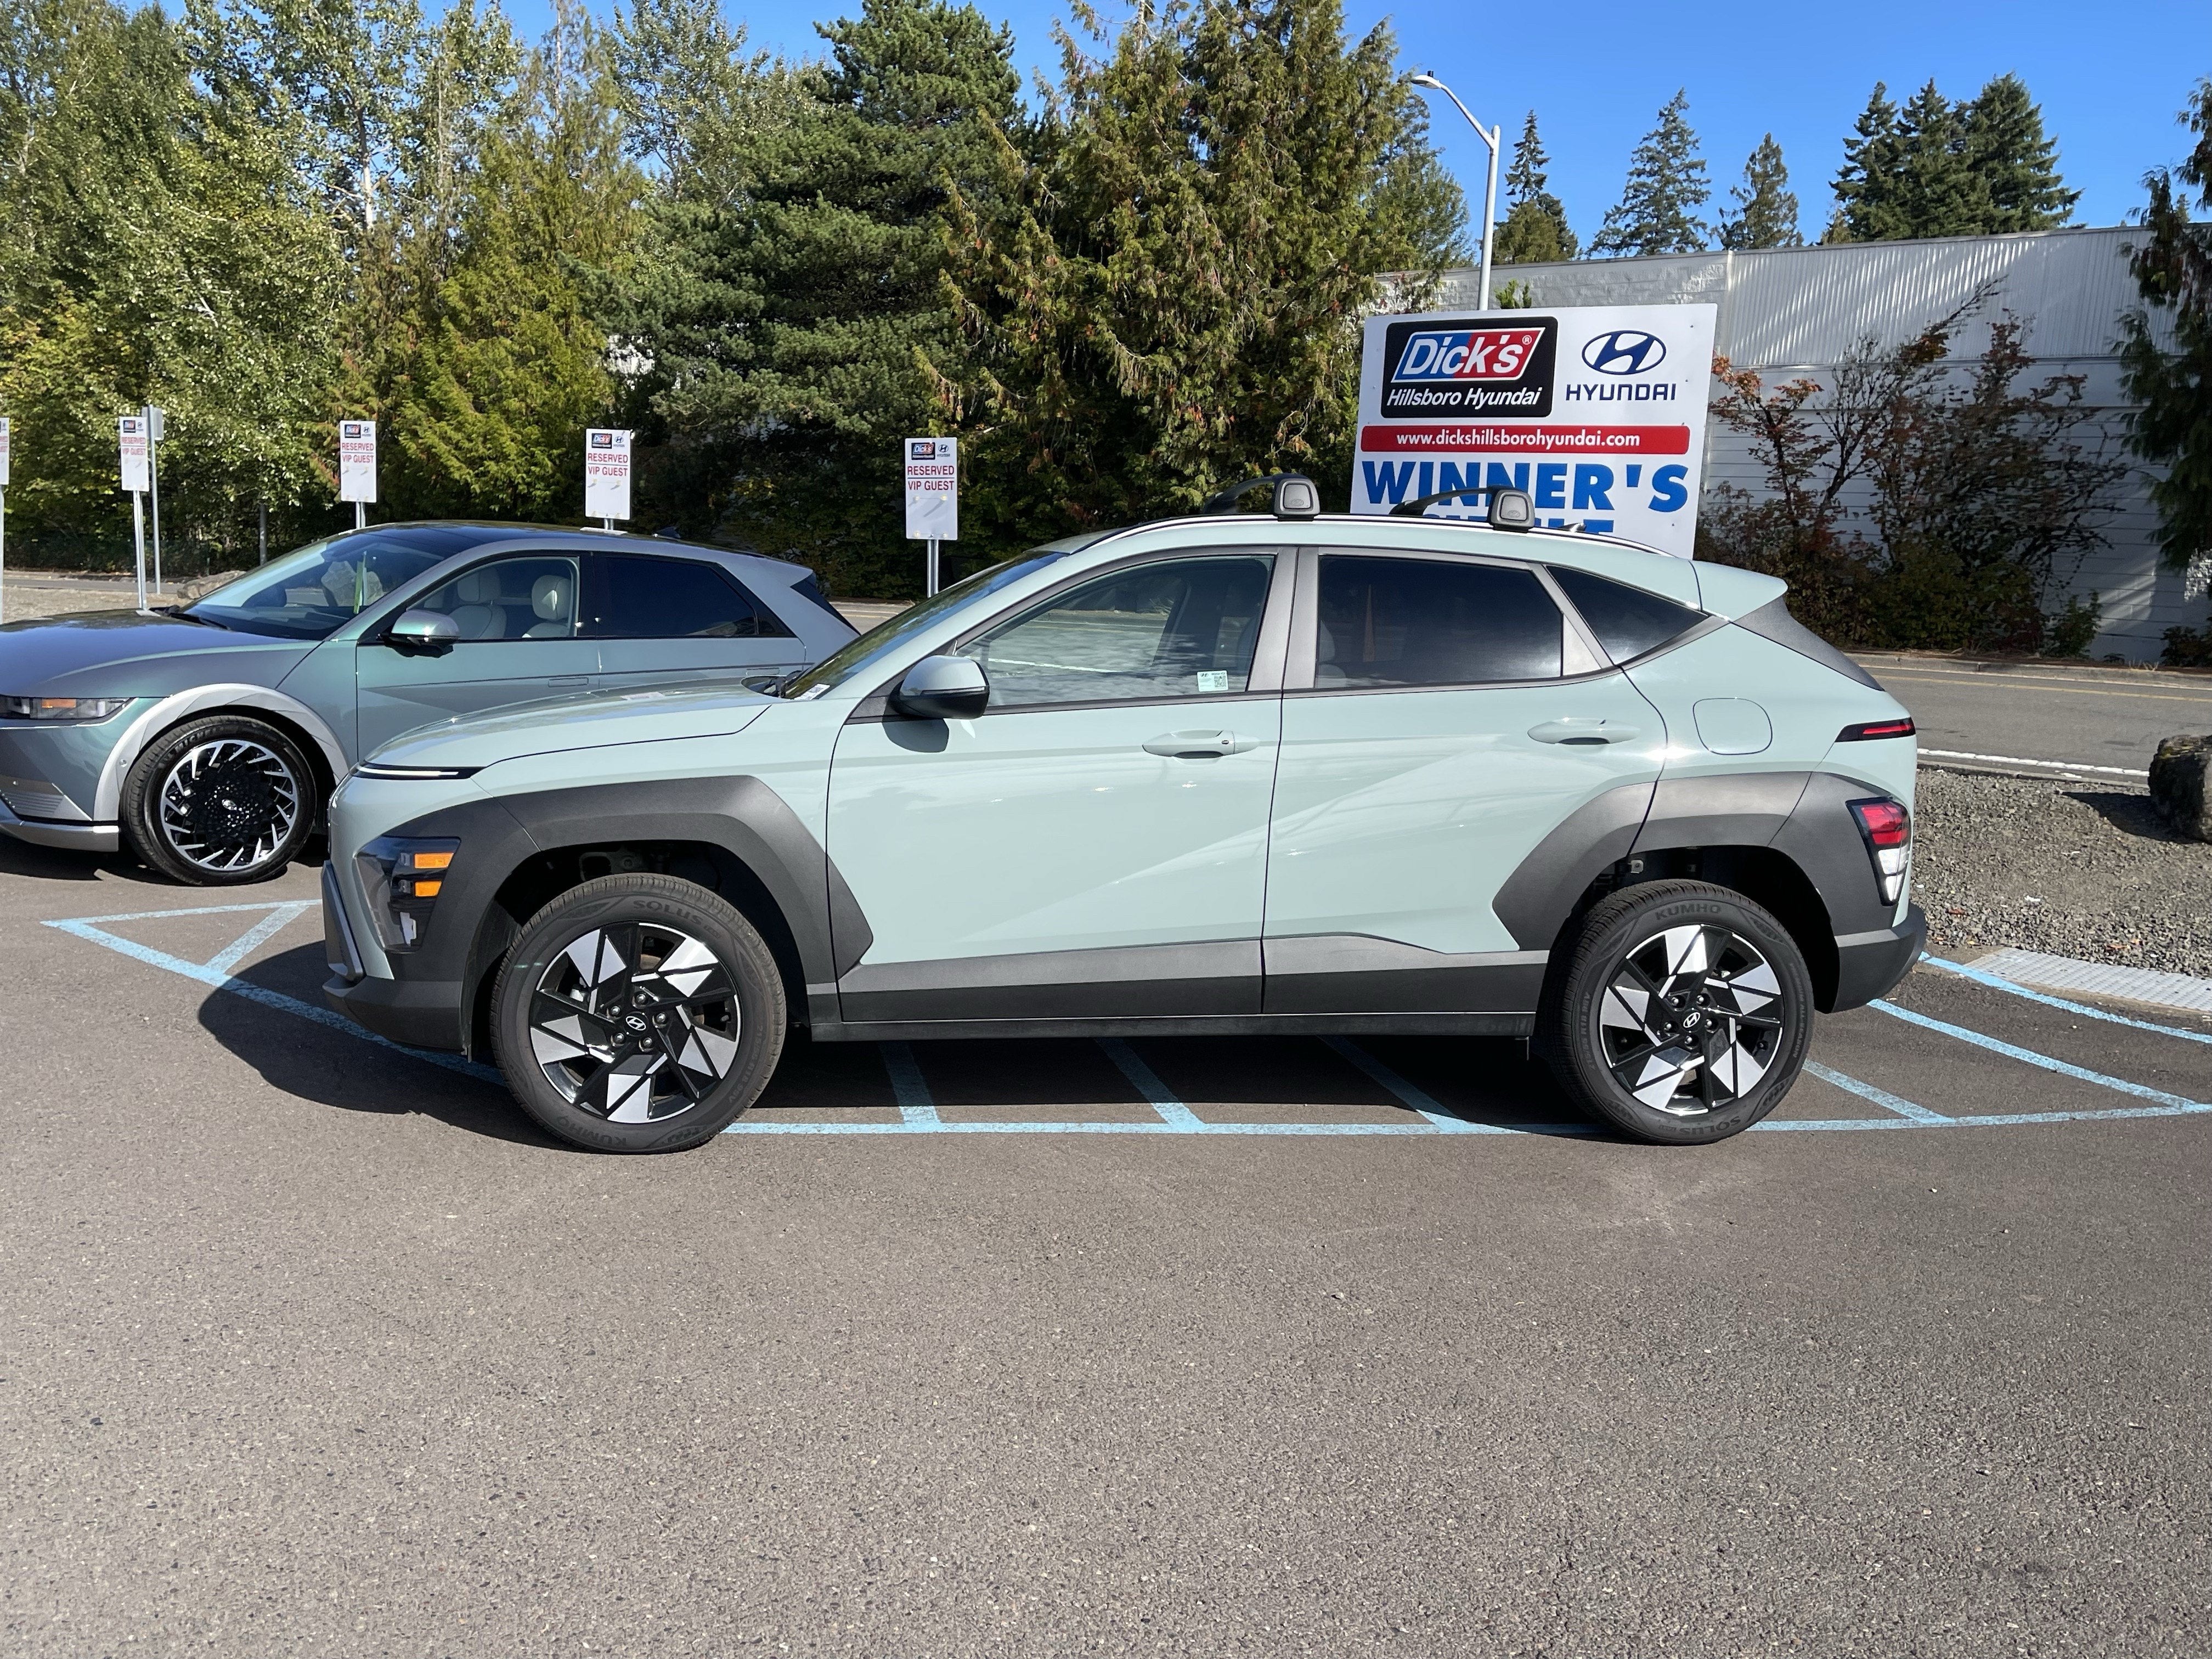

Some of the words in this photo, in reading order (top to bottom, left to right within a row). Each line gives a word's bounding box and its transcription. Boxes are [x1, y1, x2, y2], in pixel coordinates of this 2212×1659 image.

[1402, 334, 1523, 375] Dick's
[1387, 389, 1462, 408] Hillsboro
[1464, 387, 1542, 409] Hyundai
[1566, 383, 1676, 401] HYUNDAI
[342, 443, 374, 451] RESERVED
[1397, 430, 1640, 450] www.dickshillsborohyundai.com
[353, 455, 374, 463] GUEST
[588, 453, 628, 464] RESERVED
[588, 466, 600, 475] VIP
[602, 467, 628, 476] GUEST
[907, 465, 955, 476] RESERVED
[908, 481, 922, 490] VIP
[924, 481, 955, 490] GUEST
[1362, 461, 1689, 512] WINNER'S
[633, 900, 703, 925] SOLUS
[1655, 903, 1720, 920] KUMHO
